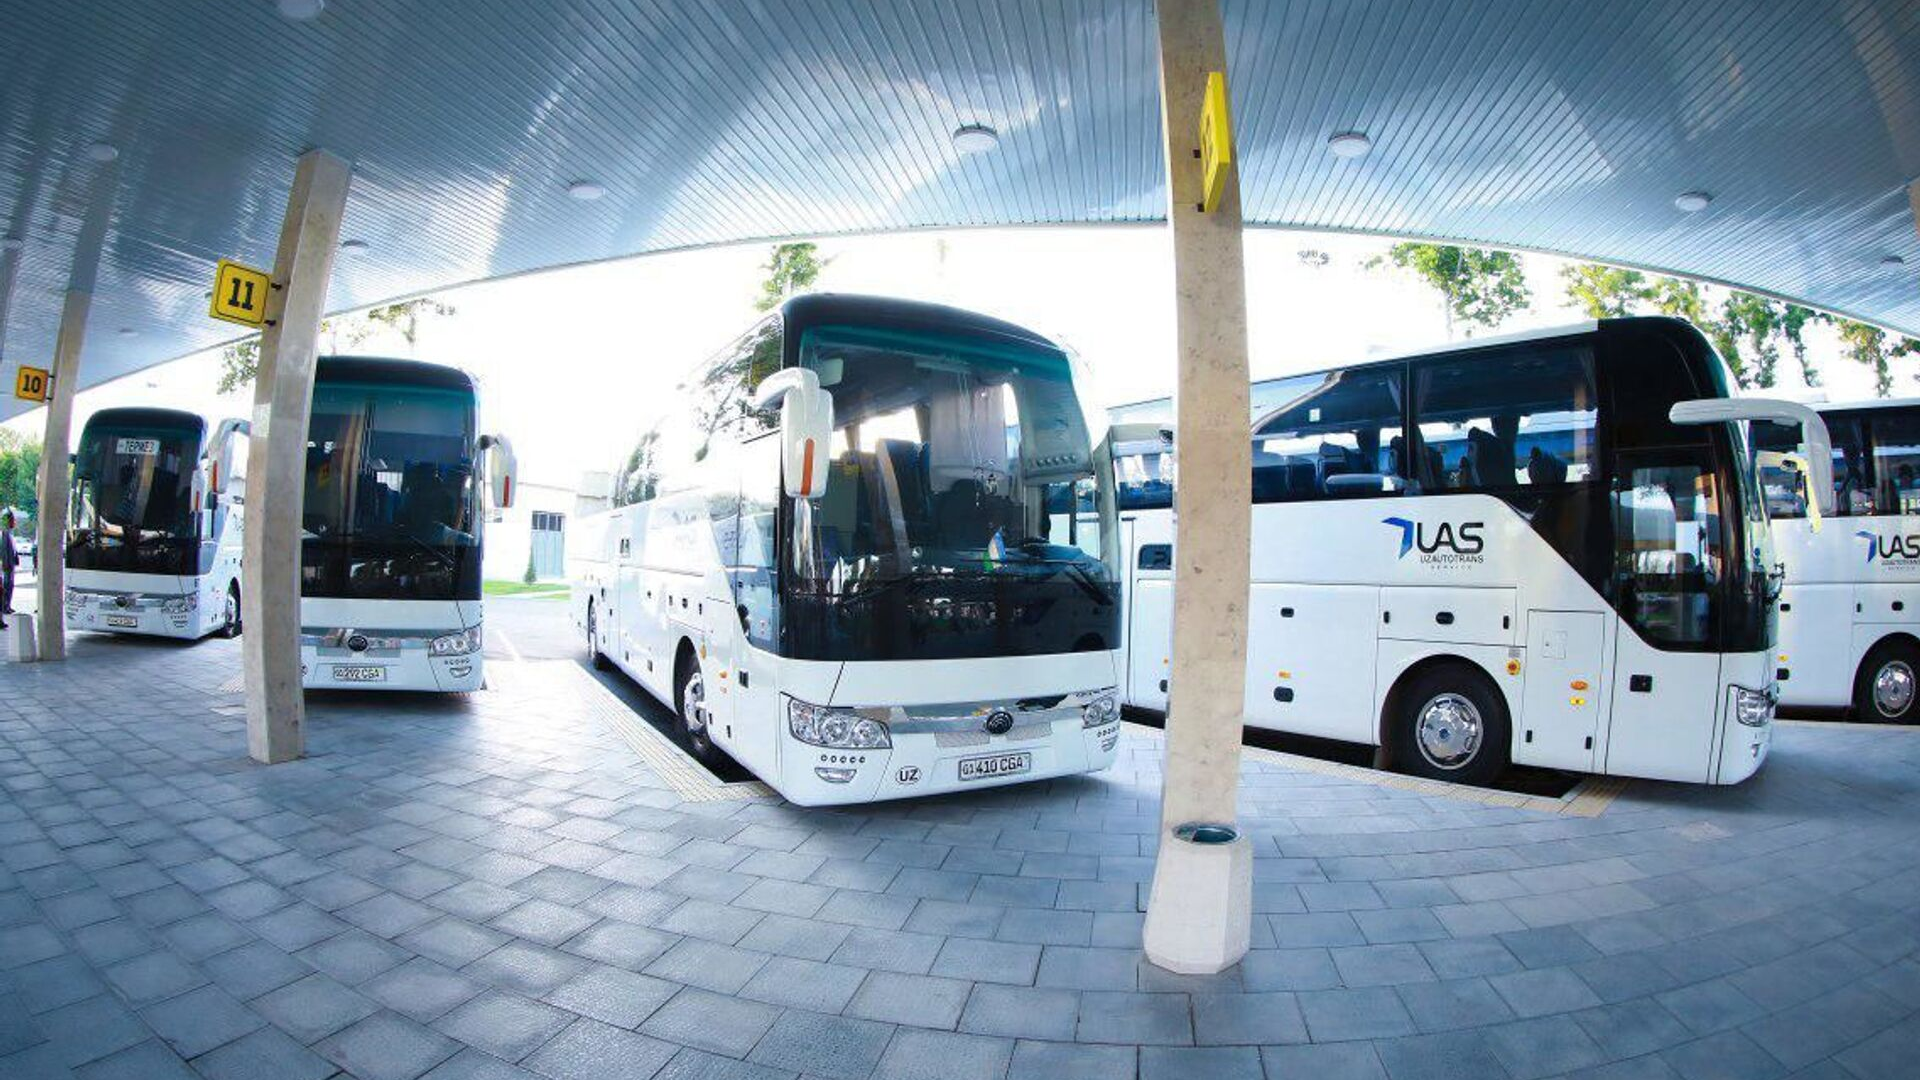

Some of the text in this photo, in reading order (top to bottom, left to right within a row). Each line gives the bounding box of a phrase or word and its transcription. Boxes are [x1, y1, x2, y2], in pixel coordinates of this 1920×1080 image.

[228, 278, 254, 310] 11
[22, 374, 41, 393] 10
[1420, 554, 1484, 563] UZAUTOTRANS
[975, 760, 998, 774] 410
[1000, 757, 1023, 771] CGA
[900, 769, 919, 782] UZ
